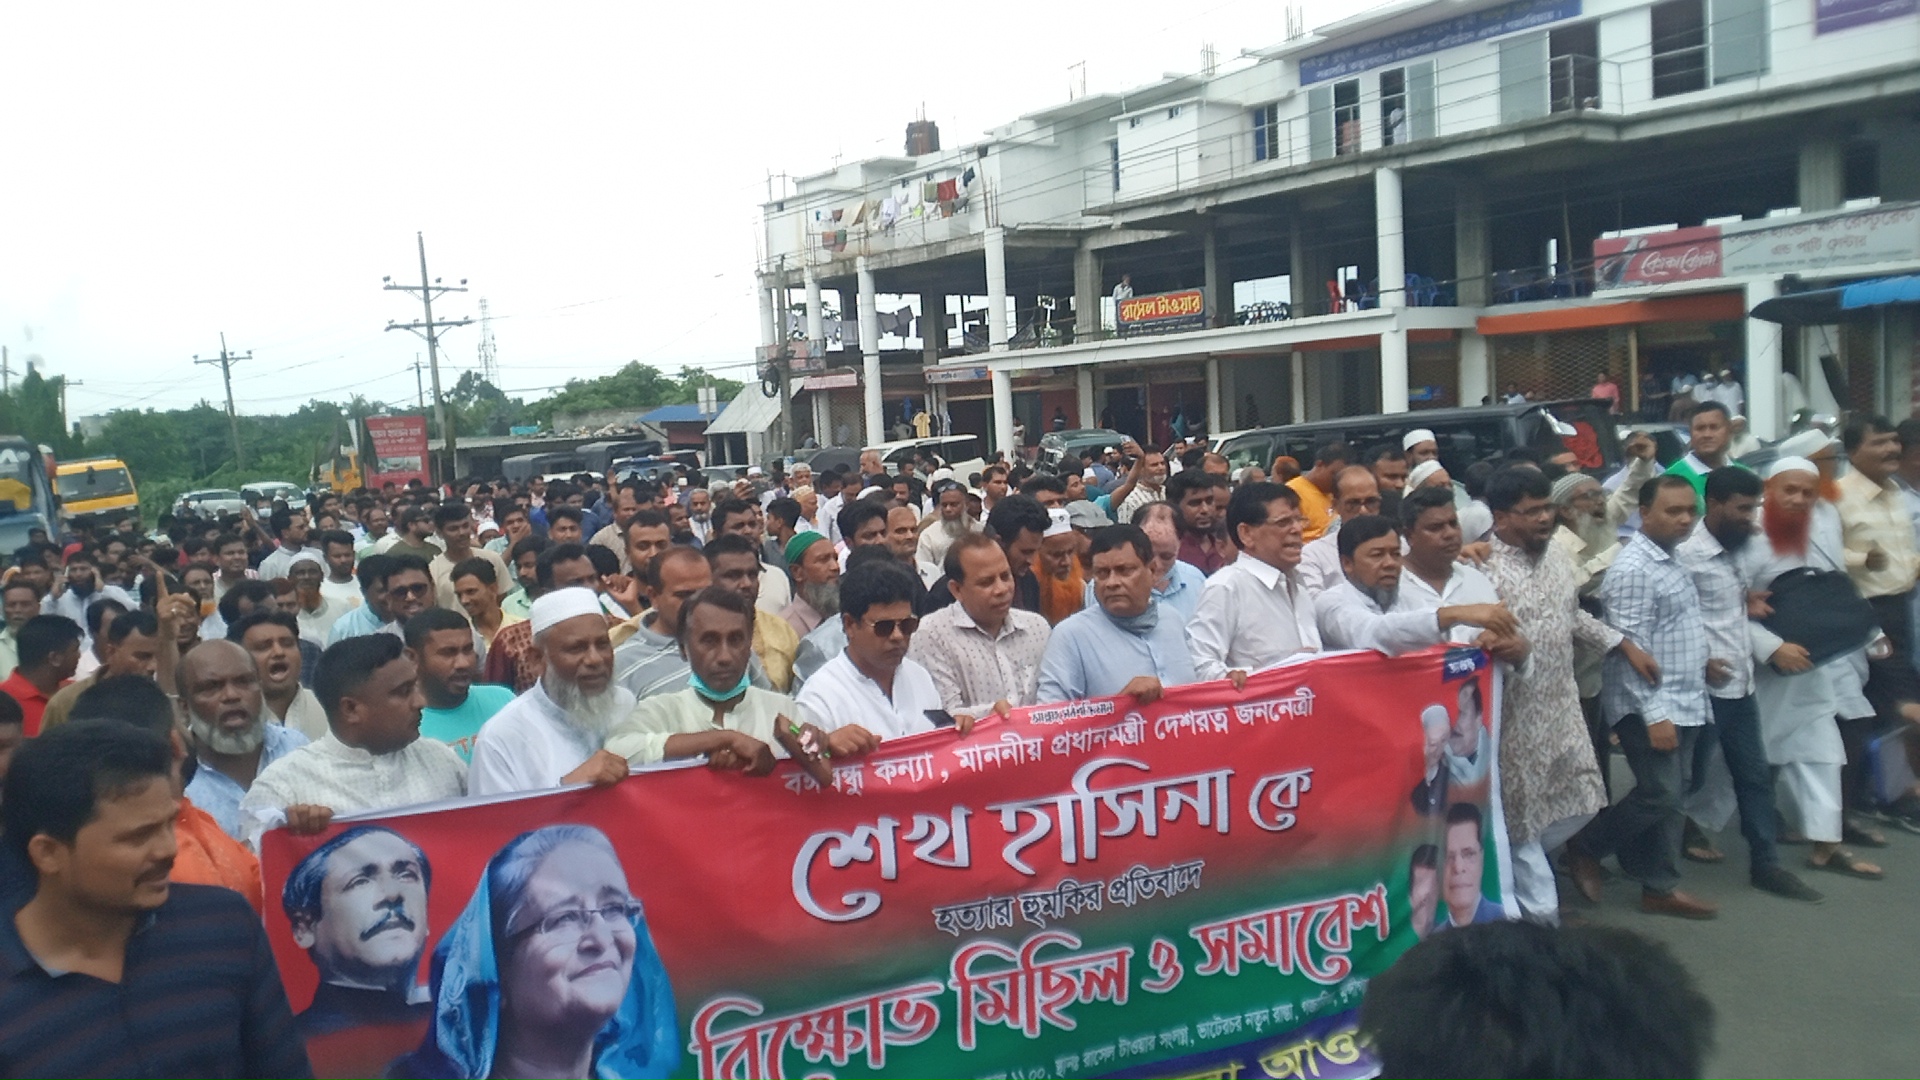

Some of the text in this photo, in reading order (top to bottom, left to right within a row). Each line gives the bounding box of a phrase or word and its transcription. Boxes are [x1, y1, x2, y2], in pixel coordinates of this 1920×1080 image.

[1121, 295, 1201, 321] রাসেল টাওয়ার
[953, 731, 1044, 774] মাননীয়
[1051, 711, 1148, 757] প্রধানমন্ত্রী
[1154, 706, 1230, 740] দেশরত্ন
[1233, 686, 1316, 725] জননেত্রী
[792, 757, 1314, 923] শেখ হাসিনা কে
[934, 861, 1204, 937] হত্যার হুমকির প্রতিবাদে
[688, 883, 1391, 1080] বিক্ষোভ মিছিল ও সমাবেশ
[1082, 1045, 1116, 1068] রাসেল
[1118, 1036, 1156, 1059] টাওয়ার
[1245, 1008, 1270, 1033] নতুন
